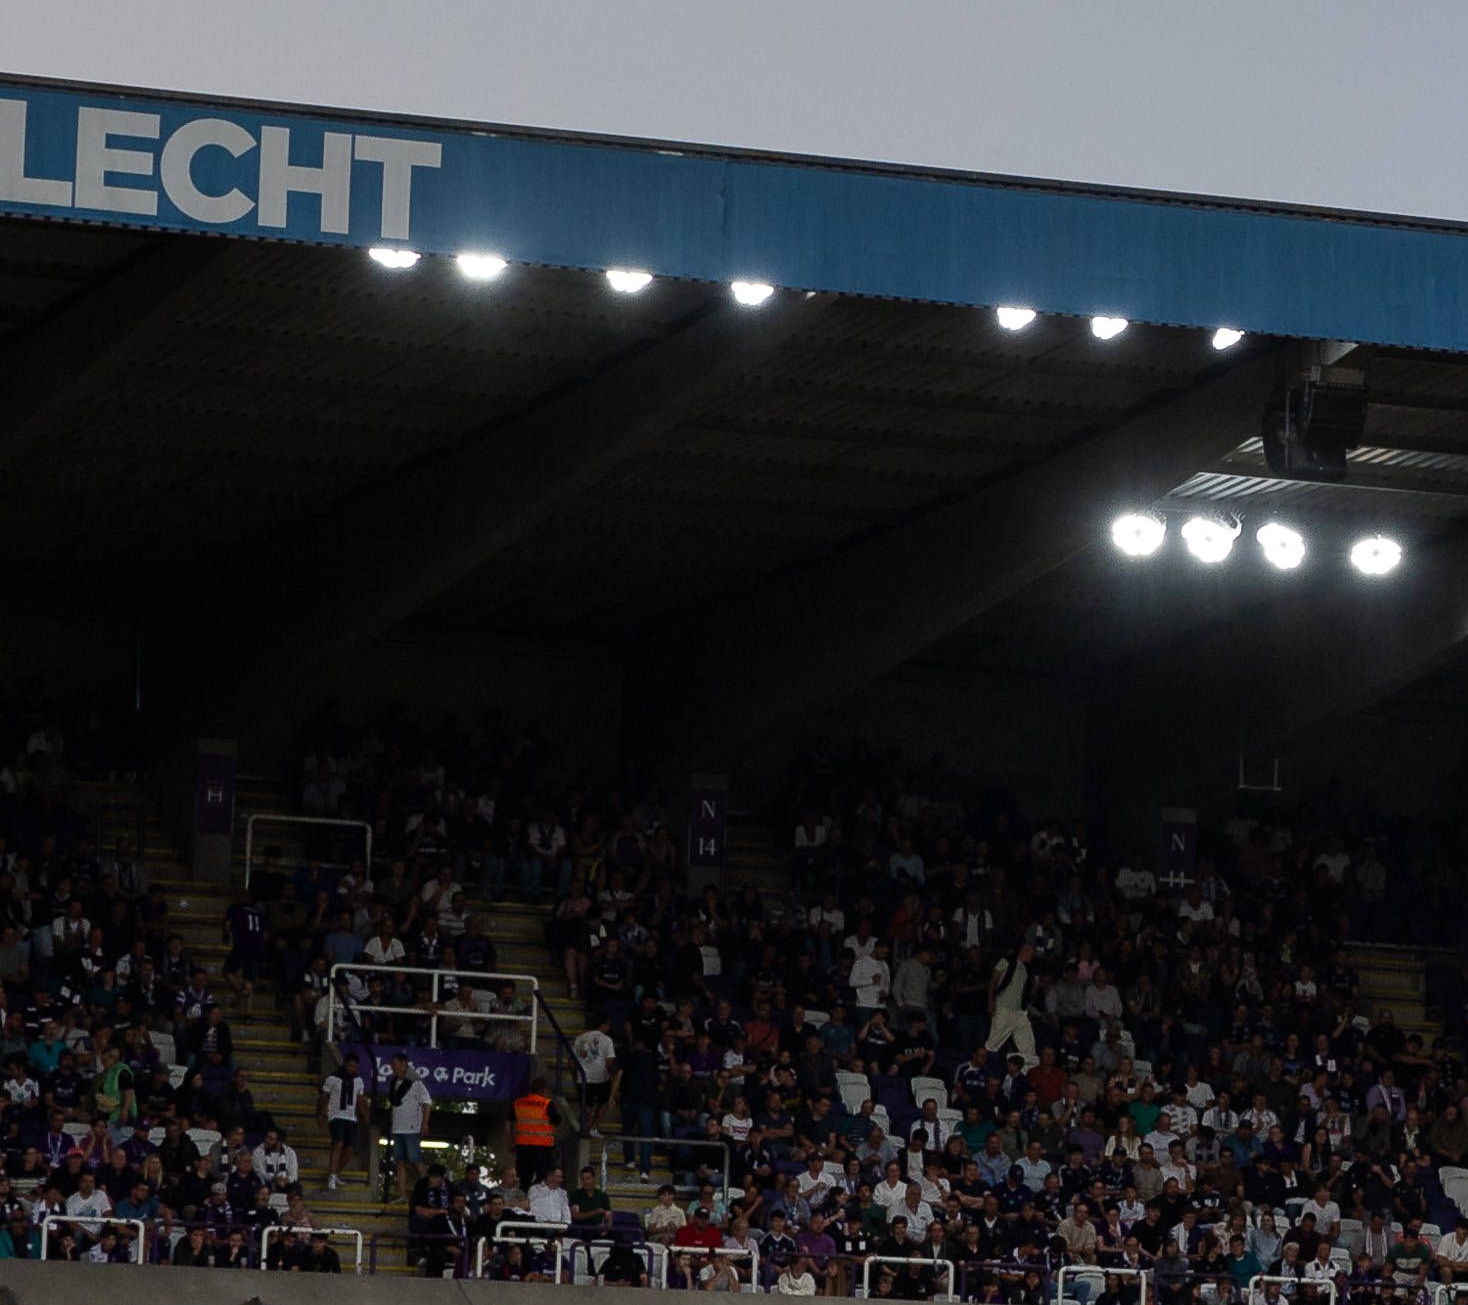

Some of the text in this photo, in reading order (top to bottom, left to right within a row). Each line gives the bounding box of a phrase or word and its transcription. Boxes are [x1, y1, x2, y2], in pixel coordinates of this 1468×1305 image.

[0, 99, 442, 240] LECHT
[702, 798, 716, 819] N
[698, 838, 716, 855] 14
[1172, 833, 1185, 851] N
